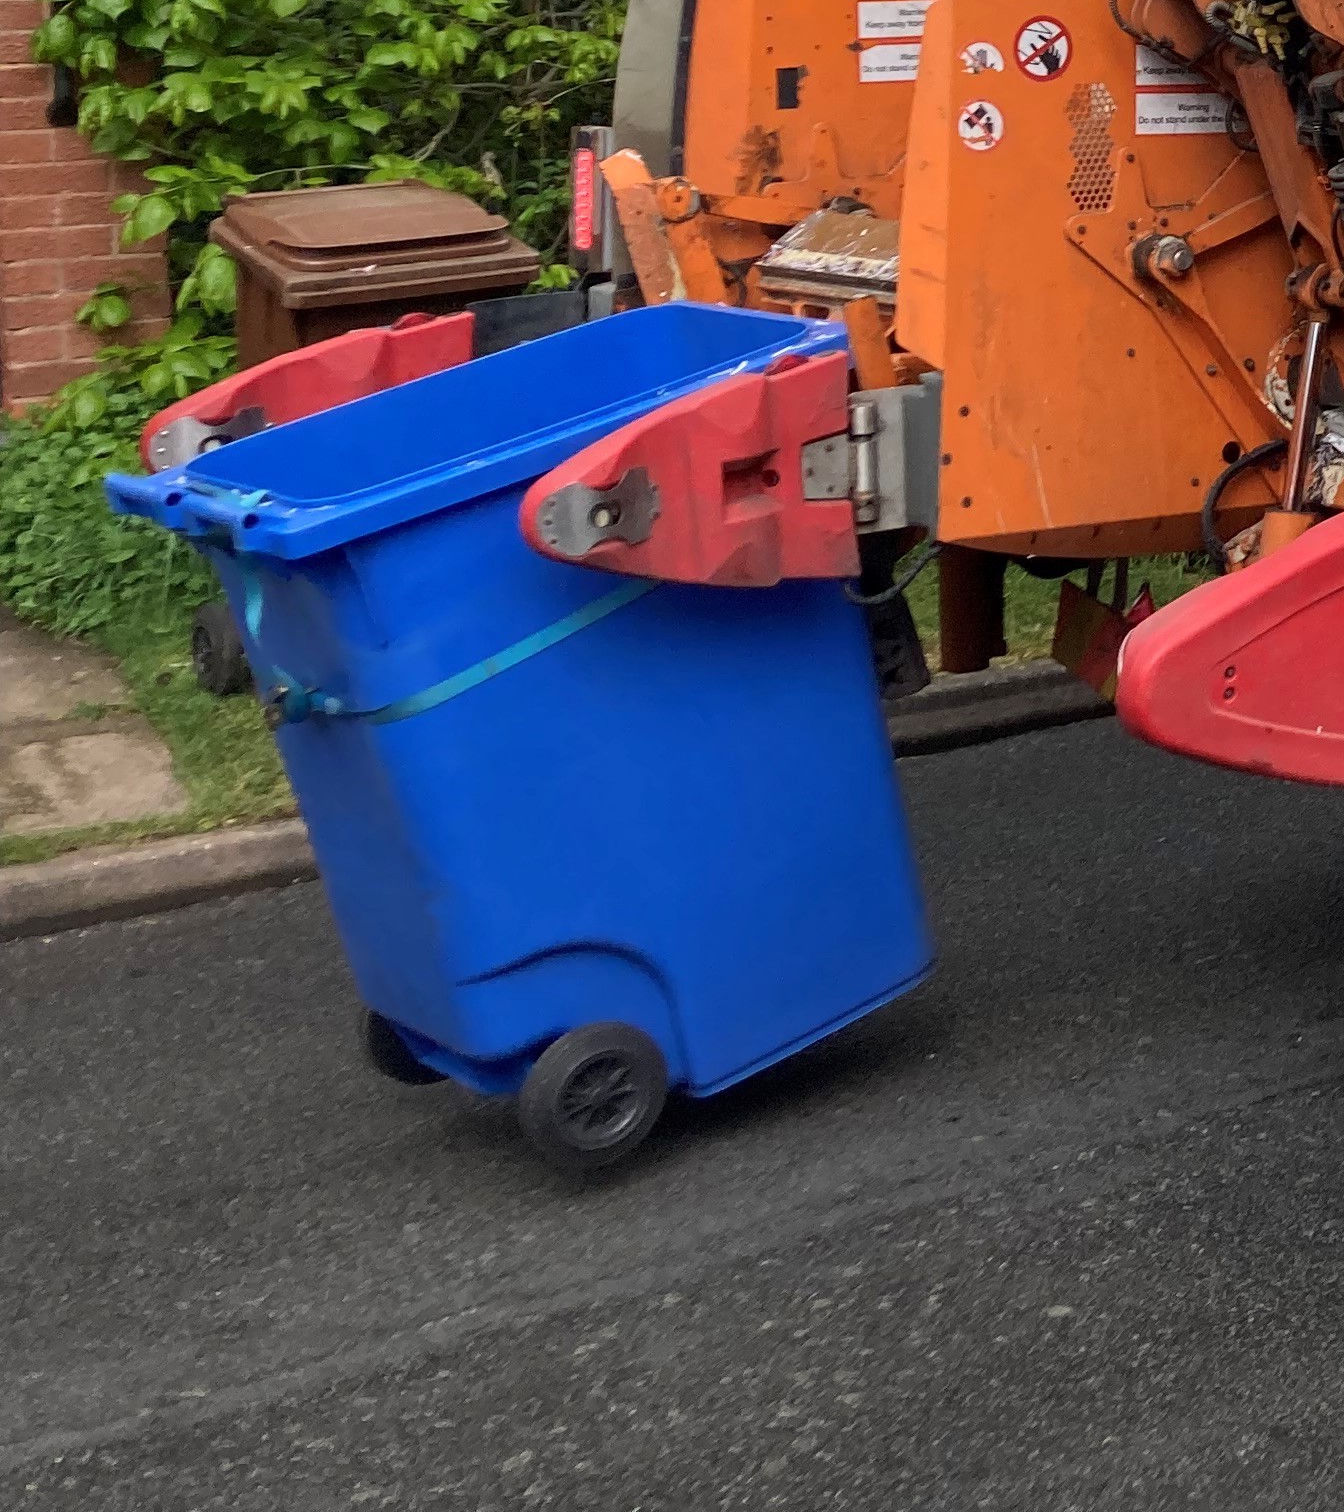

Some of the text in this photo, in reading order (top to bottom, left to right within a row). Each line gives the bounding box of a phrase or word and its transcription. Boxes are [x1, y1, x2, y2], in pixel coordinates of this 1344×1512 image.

[1178, 103, 1210, 114] Warning
[1138, 116, 1150, 124] Do
[1151, 116, 1164, 124] not
[1165, 116, 1187, 124] stand
[1188, 115, 1212, 123] under
